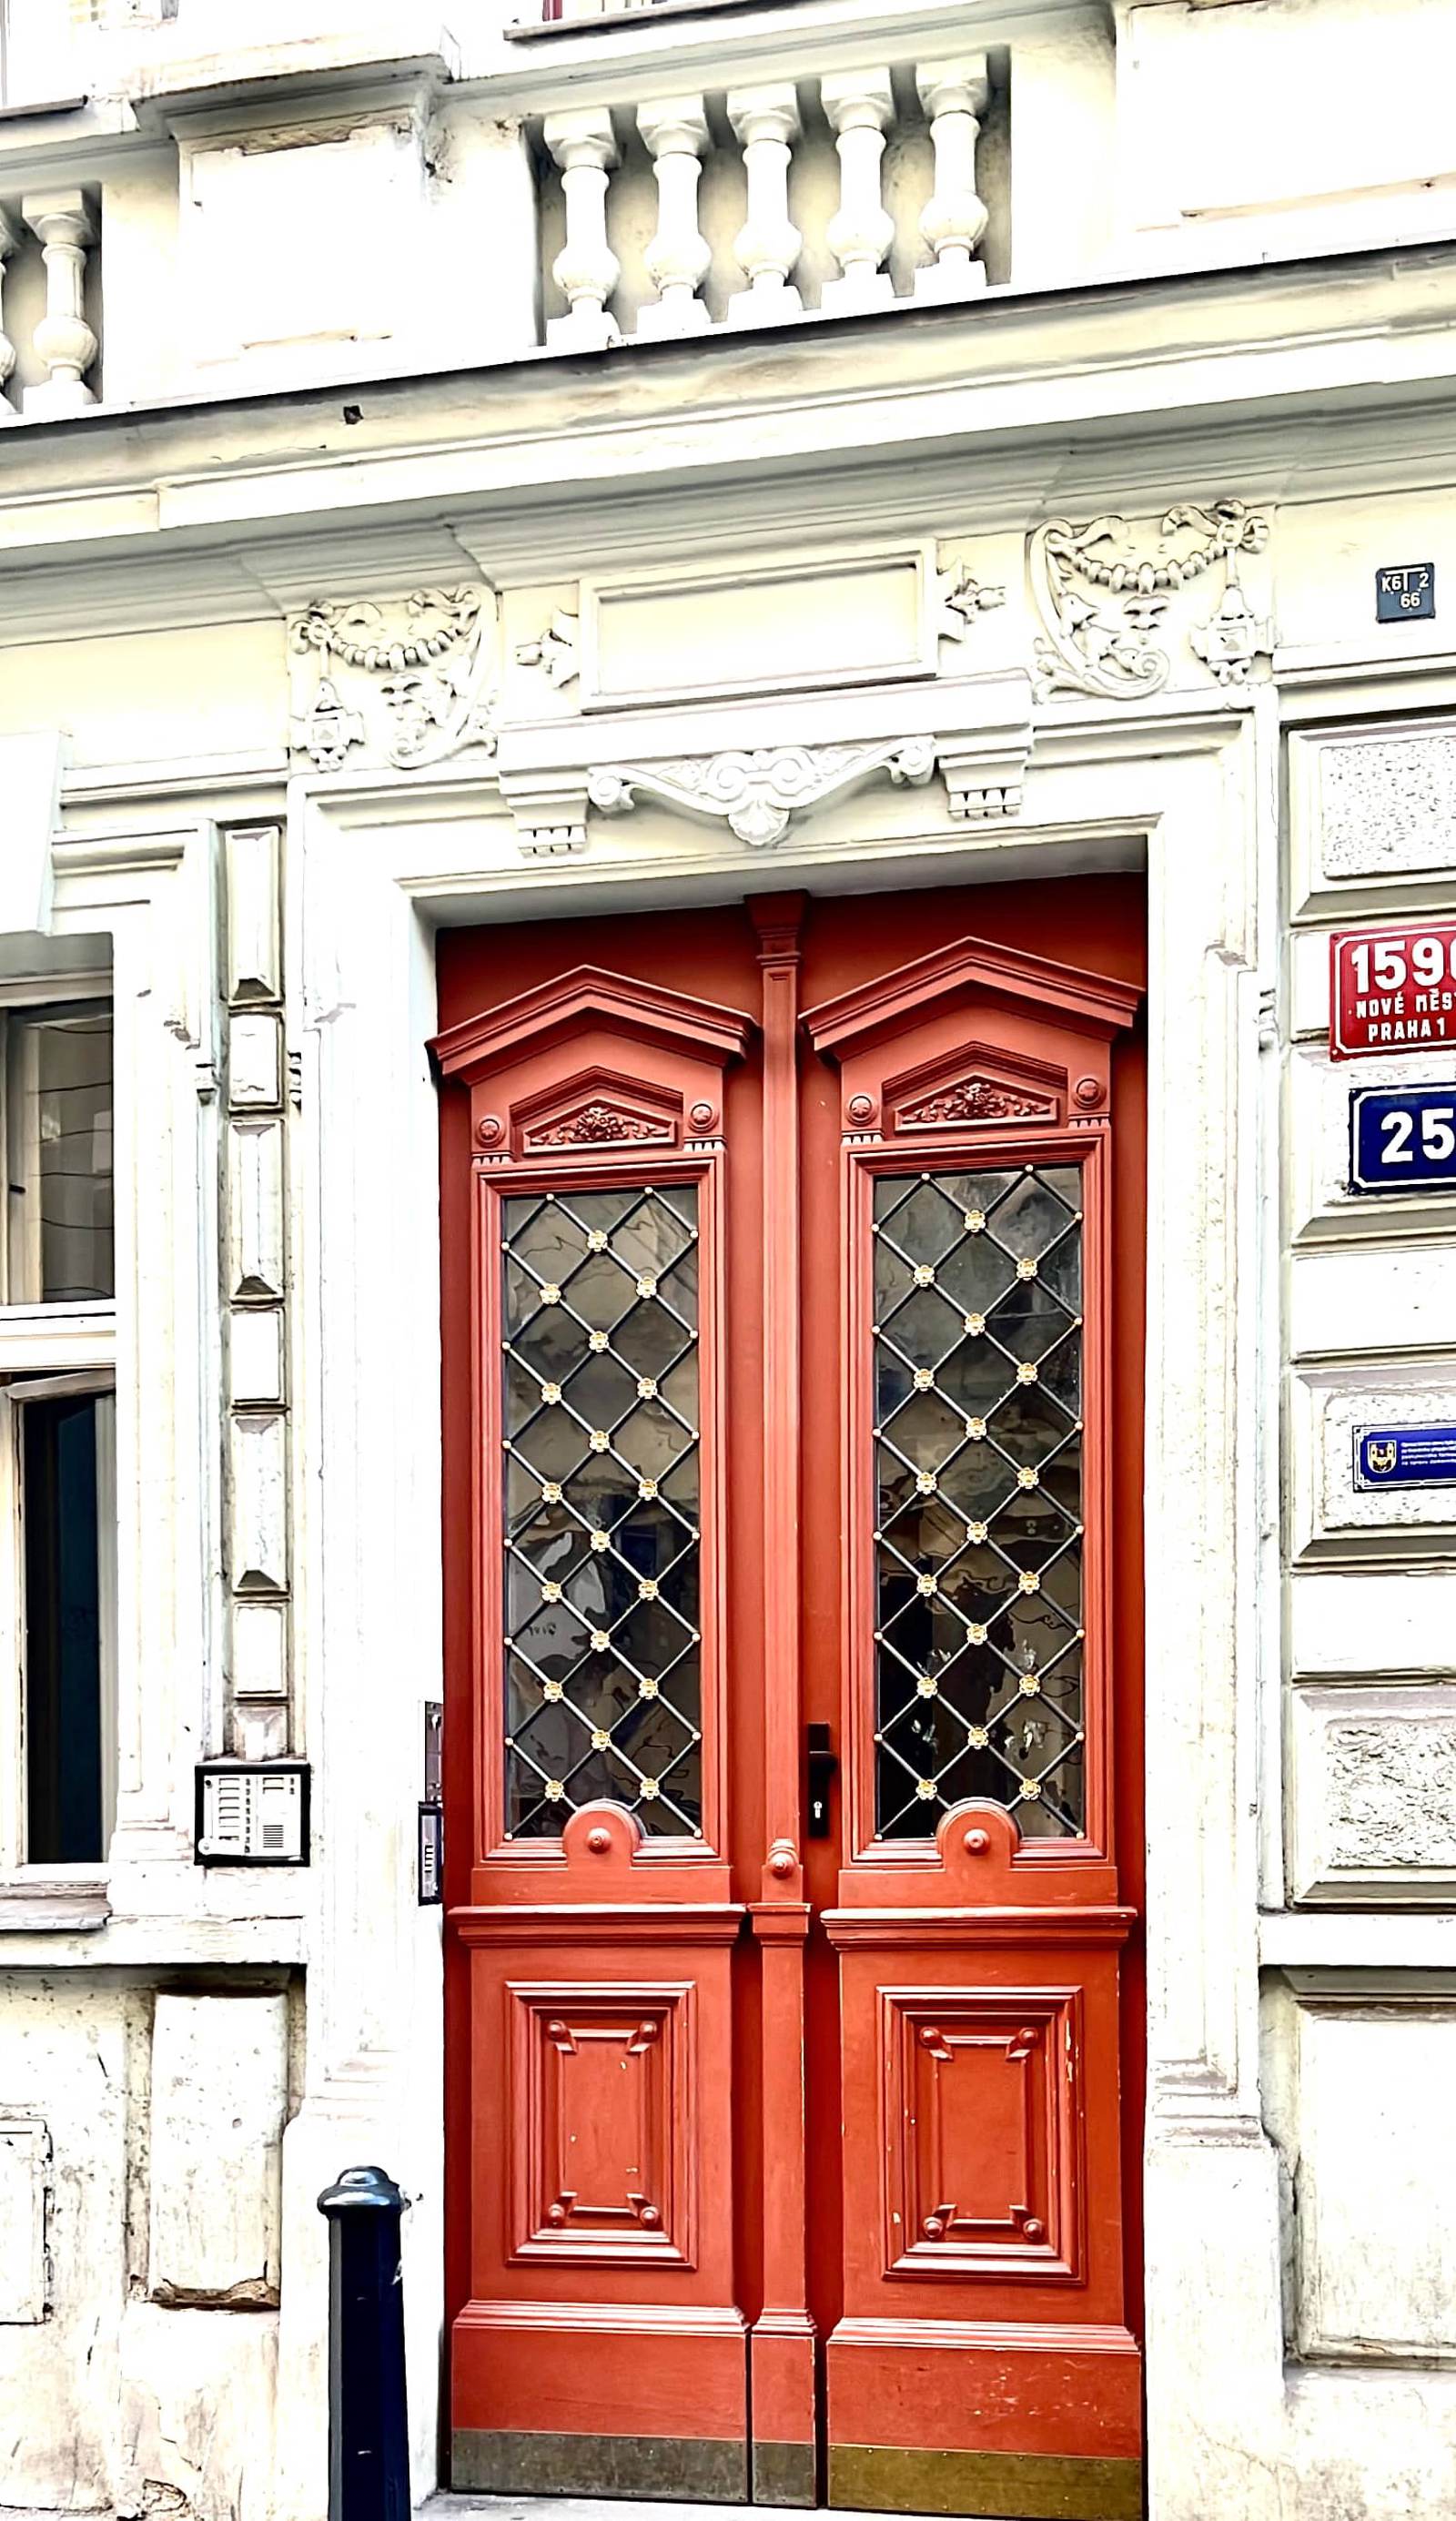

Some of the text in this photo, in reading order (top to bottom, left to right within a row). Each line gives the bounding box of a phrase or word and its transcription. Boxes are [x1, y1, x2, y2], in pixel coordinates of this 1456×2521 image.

[1400, 592, 1421, 608] 66
[1350, 937, 1456, 994] 159
[1355, 987, 1456, 1019] NOVÉ MĚS
[1368, 1017, 1445, 1042] PRAHA 1
[1380, 1108, 1456, 1164] 25
